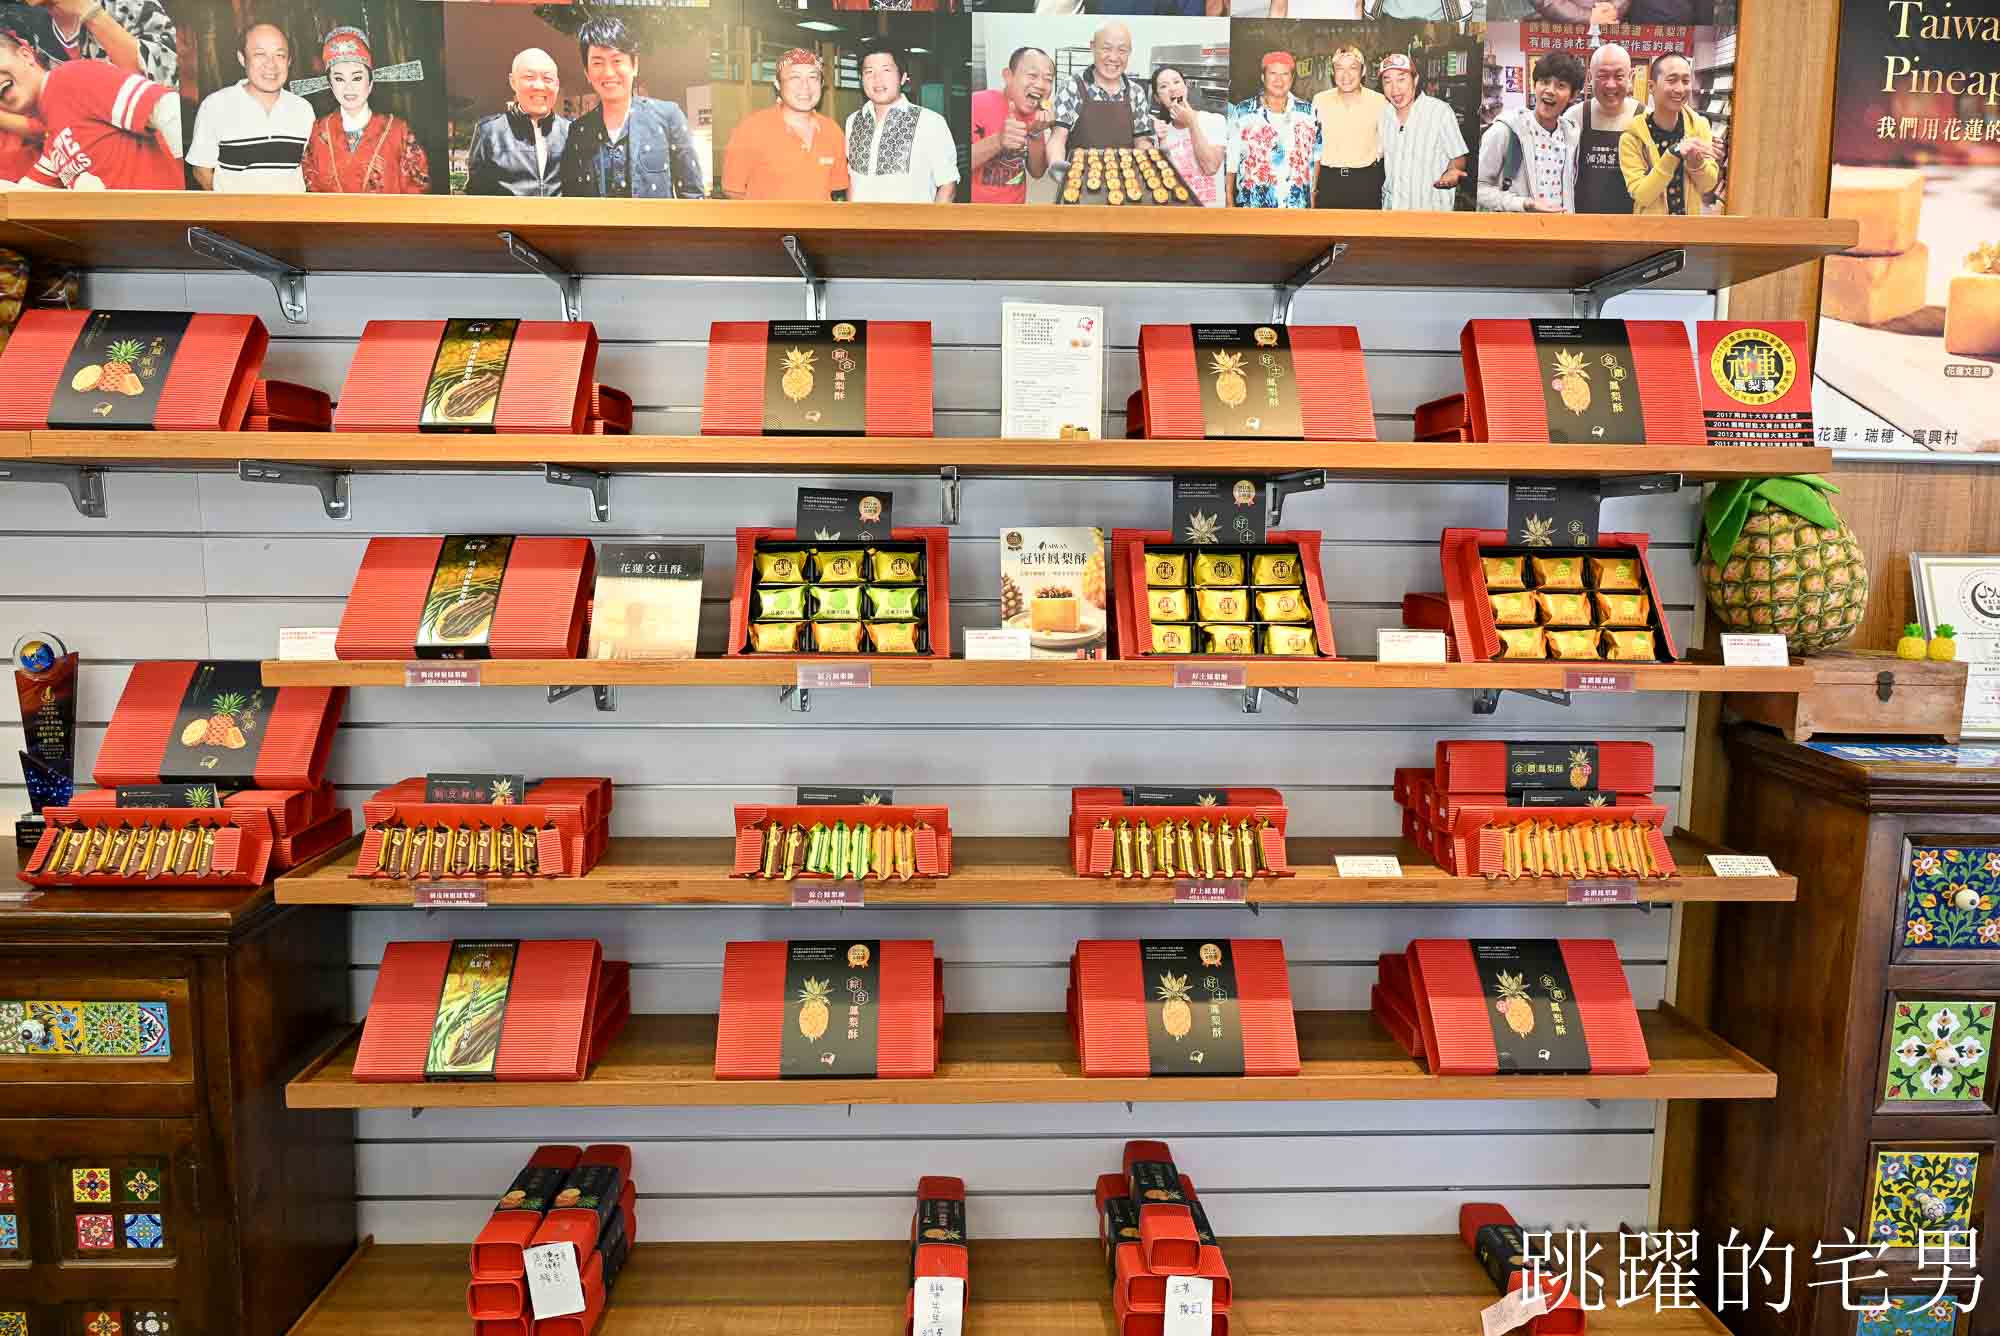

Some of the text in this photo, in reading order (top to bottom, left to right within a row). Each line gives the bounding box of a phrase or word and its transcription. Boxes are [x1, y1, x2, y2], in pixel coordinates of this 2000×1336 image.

[1880, 55, 2000, 105] Pineap
[1877, 115, 2000, 142] 我們用花蓮的
[620, 561, 683, 574] 花蓮文旦酥
[1020, 551, 1088, 566] 冠軍鳳梨酥
